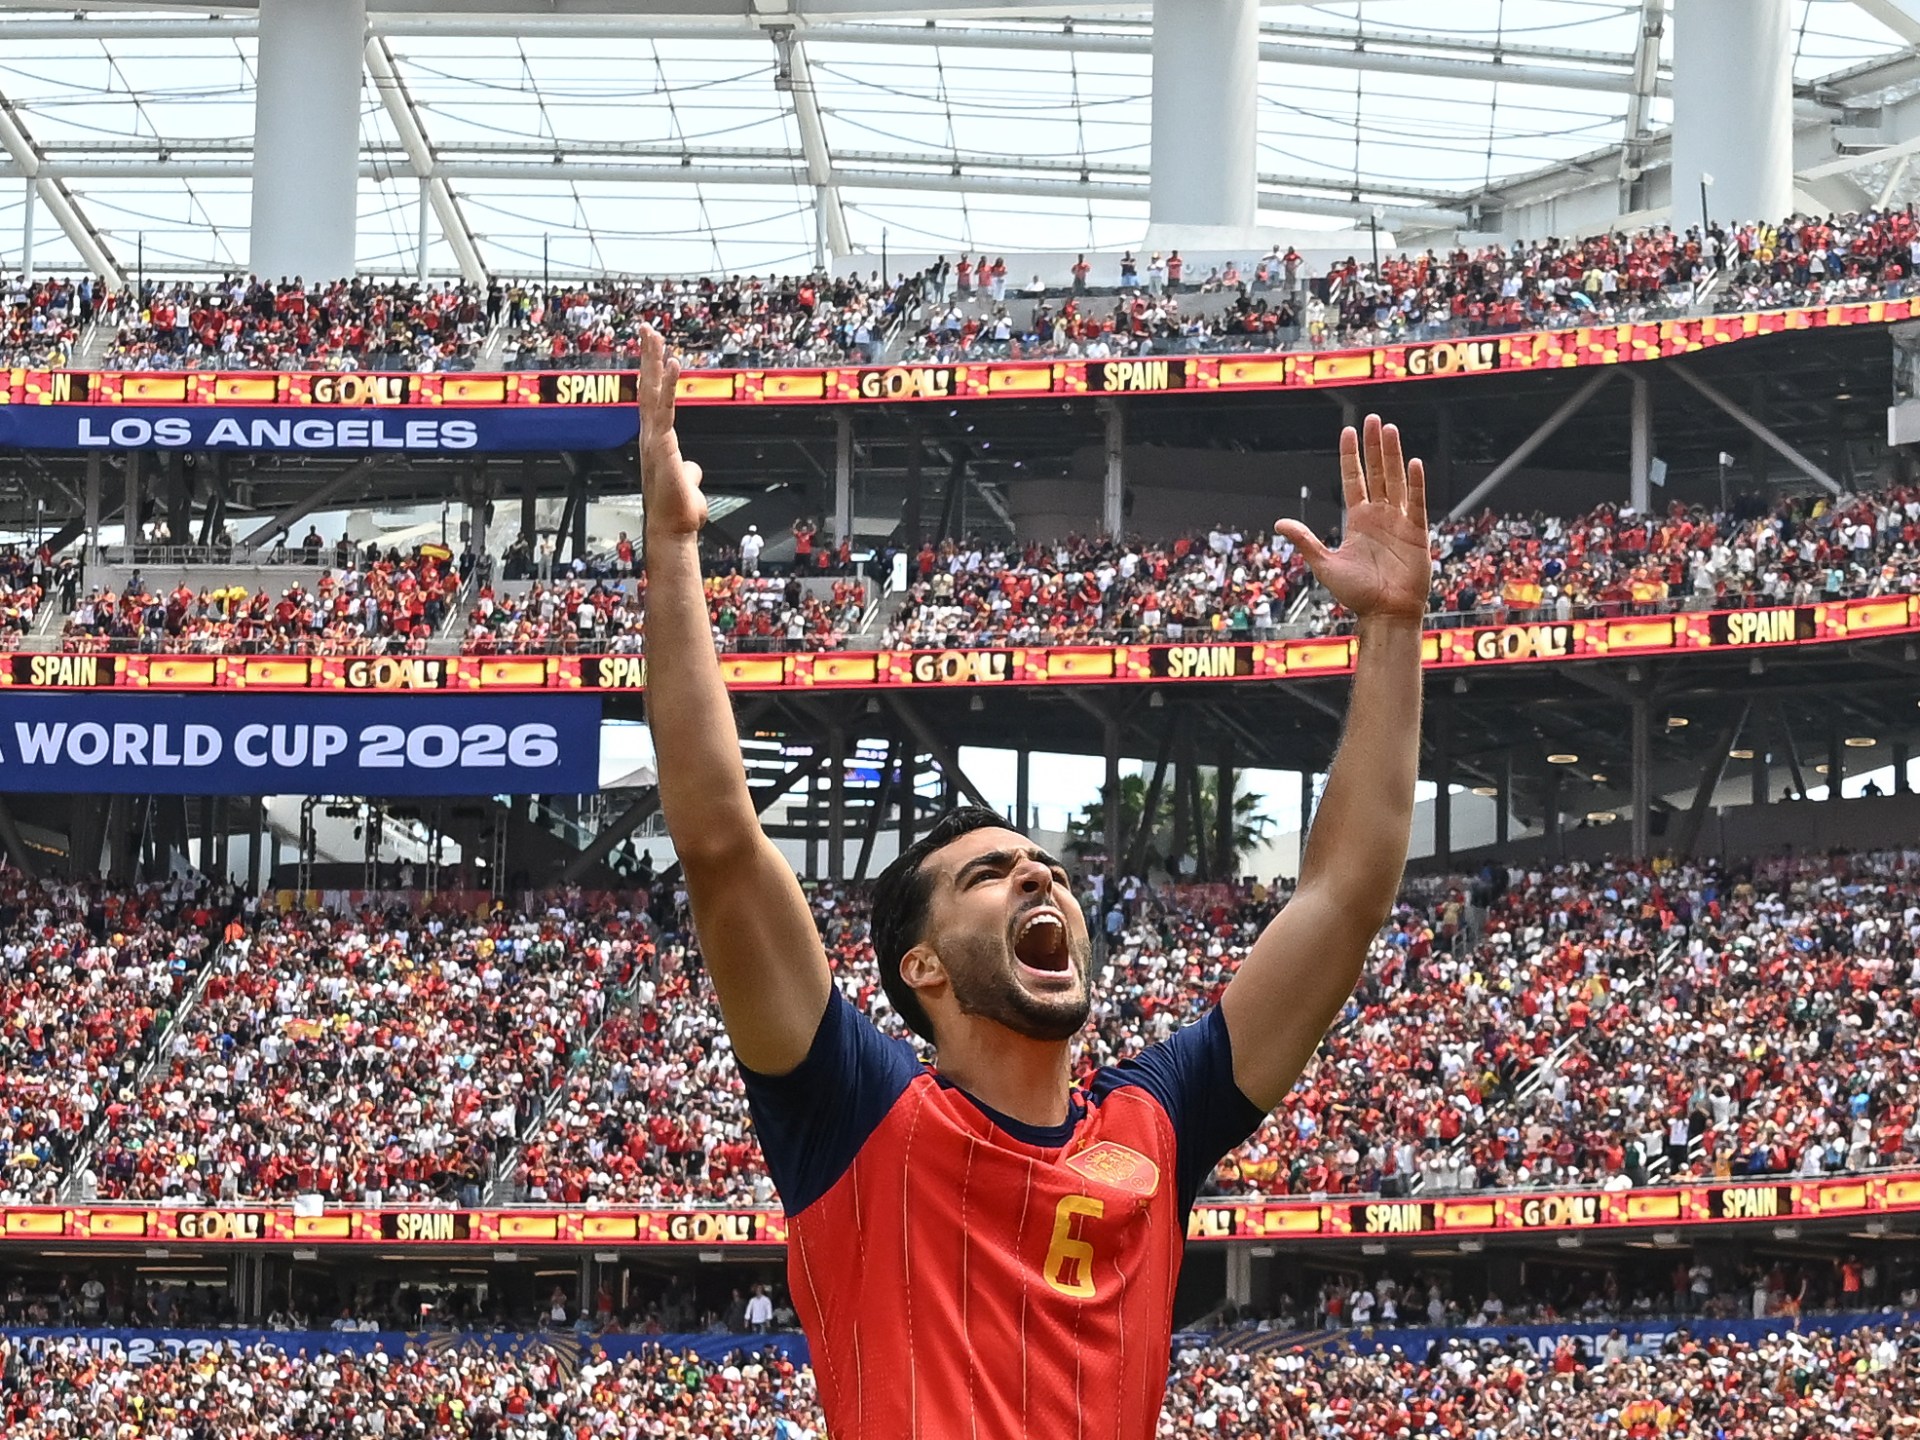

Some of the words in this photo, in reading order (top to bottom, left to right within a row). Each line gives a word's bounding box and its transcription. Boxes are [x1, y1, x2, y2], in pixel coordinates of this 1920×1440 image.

[1407, 342, 1494, 375] GOAL!
[314, 375, 403, 405] GOAL!
[556, 374, 620, 404] SPAIN
[861, 367, 949, 399] GOAL!
[1103, 360, 1169, 392] SPAIN
[78, 418, 192, 446] LOS
[205, 418, 478, 448] ANGELES
[1477, 626, 1568, 660] GOAL!
[1727, 610, 1795, 645] SPAIN
[30, 656, 97, 686] SPAIN
[349, 656, 440, 689] GOAL!
[915, 651, 1006, 683] GOAL!
[1167, 646, 1236, 678] SPAIN
[14, 721, 223, 767] WORLD
[233, 723, 348, 768] CUP
[358, 723, 559, 768] 2026
[1524, 1195, 1597, 1226] GOAL!
[1722, 1187, 1778, 1217] SPAIN
[180, 1211, 259, 1239] GOAL!
[396, 1213, 455, 1241] SPAIN
[671, 1213, 750, 1242] GOAL!
[1365, 1204, 1421, 1232] SPAIN
[1043, 1194, 1105, 1298] 6
